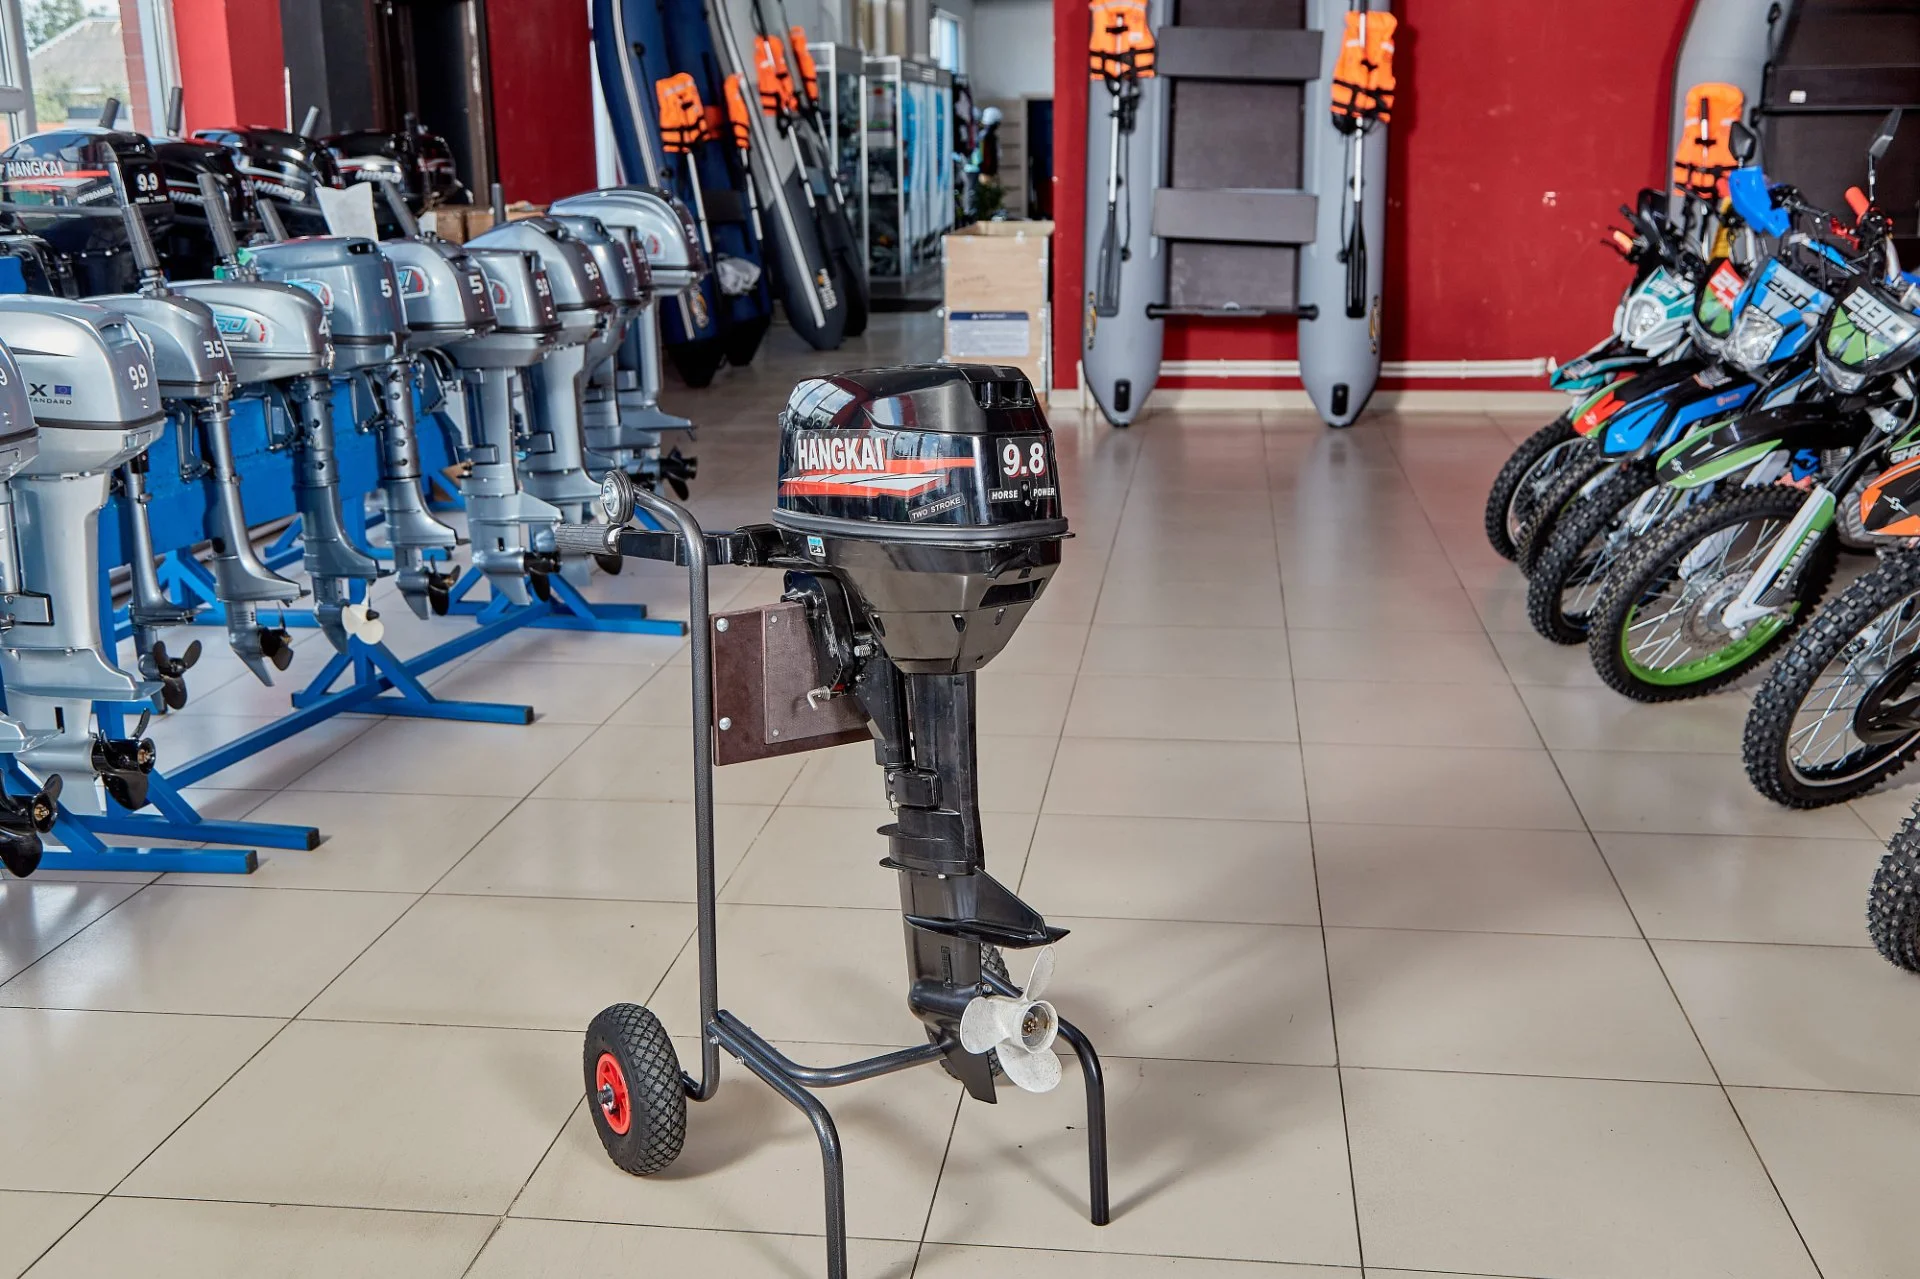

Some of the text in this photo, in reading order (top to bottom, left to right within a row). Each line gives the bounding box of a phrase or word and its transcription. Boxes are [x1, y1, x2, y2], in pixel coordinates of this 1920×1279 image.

[6, 161, 65, 177] HANGKAI
[136, 173, 158, 191] 9.9
[380, 278, 393, 298] 5
[468, 275, 484, 295] 5
[1765, 277, 1810, 310] 250
[128, 363, 149, 391] 9.9
[29, 396, 72, 405] TANDARD
[797, 437, 885, 471] HANGKAI
[1003, 442, 1045, 476] 9.8
[991, 487, 1055, 500] HORSE POWER
[912, 496, 961, 520] TWO STROKE
